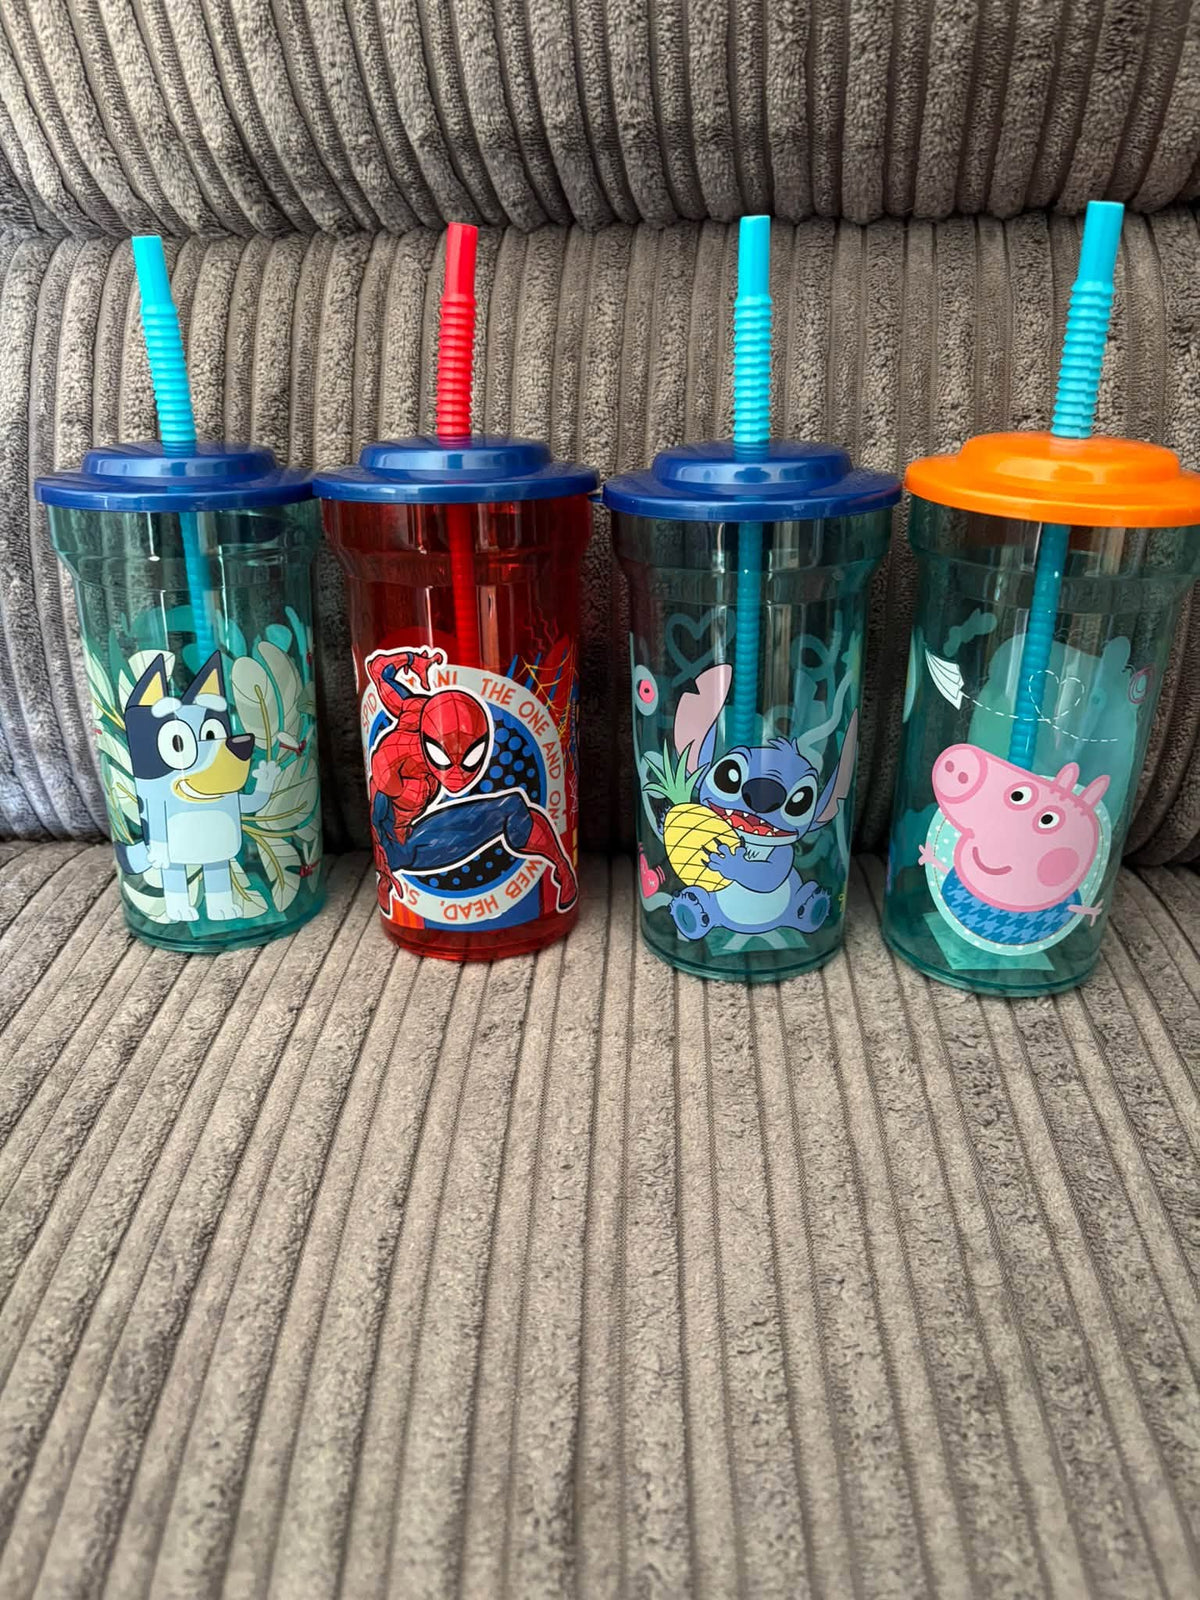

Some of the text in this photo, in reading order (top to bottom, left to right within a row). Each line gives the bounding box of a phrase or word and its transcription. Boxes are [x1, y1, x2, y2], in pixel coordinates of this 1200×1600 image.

[481, 678, 515, 705] THE
[519, 701, 549, 736] ONE
[542, 742, 561, 779] AND
[548, 791, 561, 825] ON
[505, 859, 543, 899] WEB
